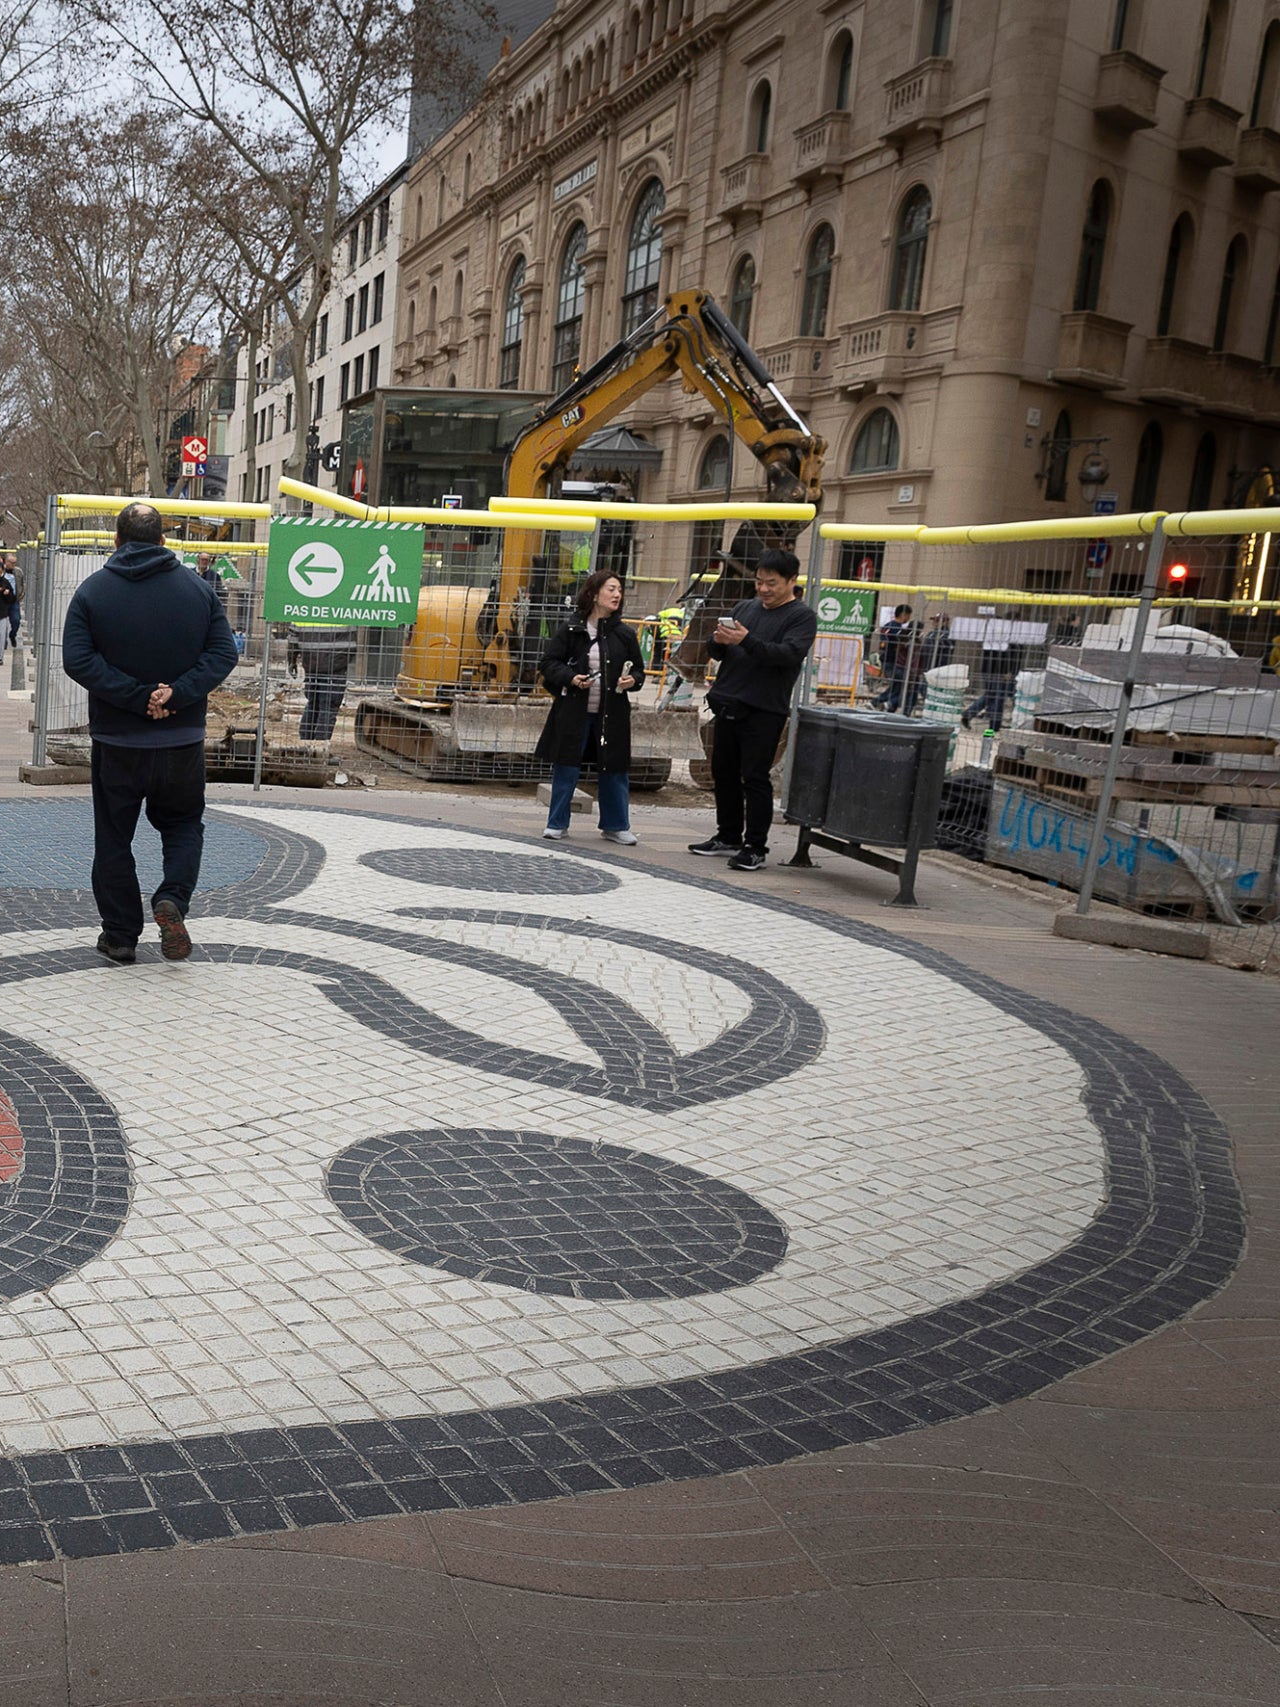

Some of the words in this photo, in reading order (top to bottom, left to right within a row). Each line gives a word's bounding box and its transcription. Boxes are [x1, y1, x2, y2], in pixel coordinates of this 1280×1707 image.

[561, 405, 580, 428] CAT
[191, 443, 200, 452] M
[283, 604, 309, 617] PAS
[311, 606, 329, 618] DE
[331, 607, 397, 621] VIANANTS
